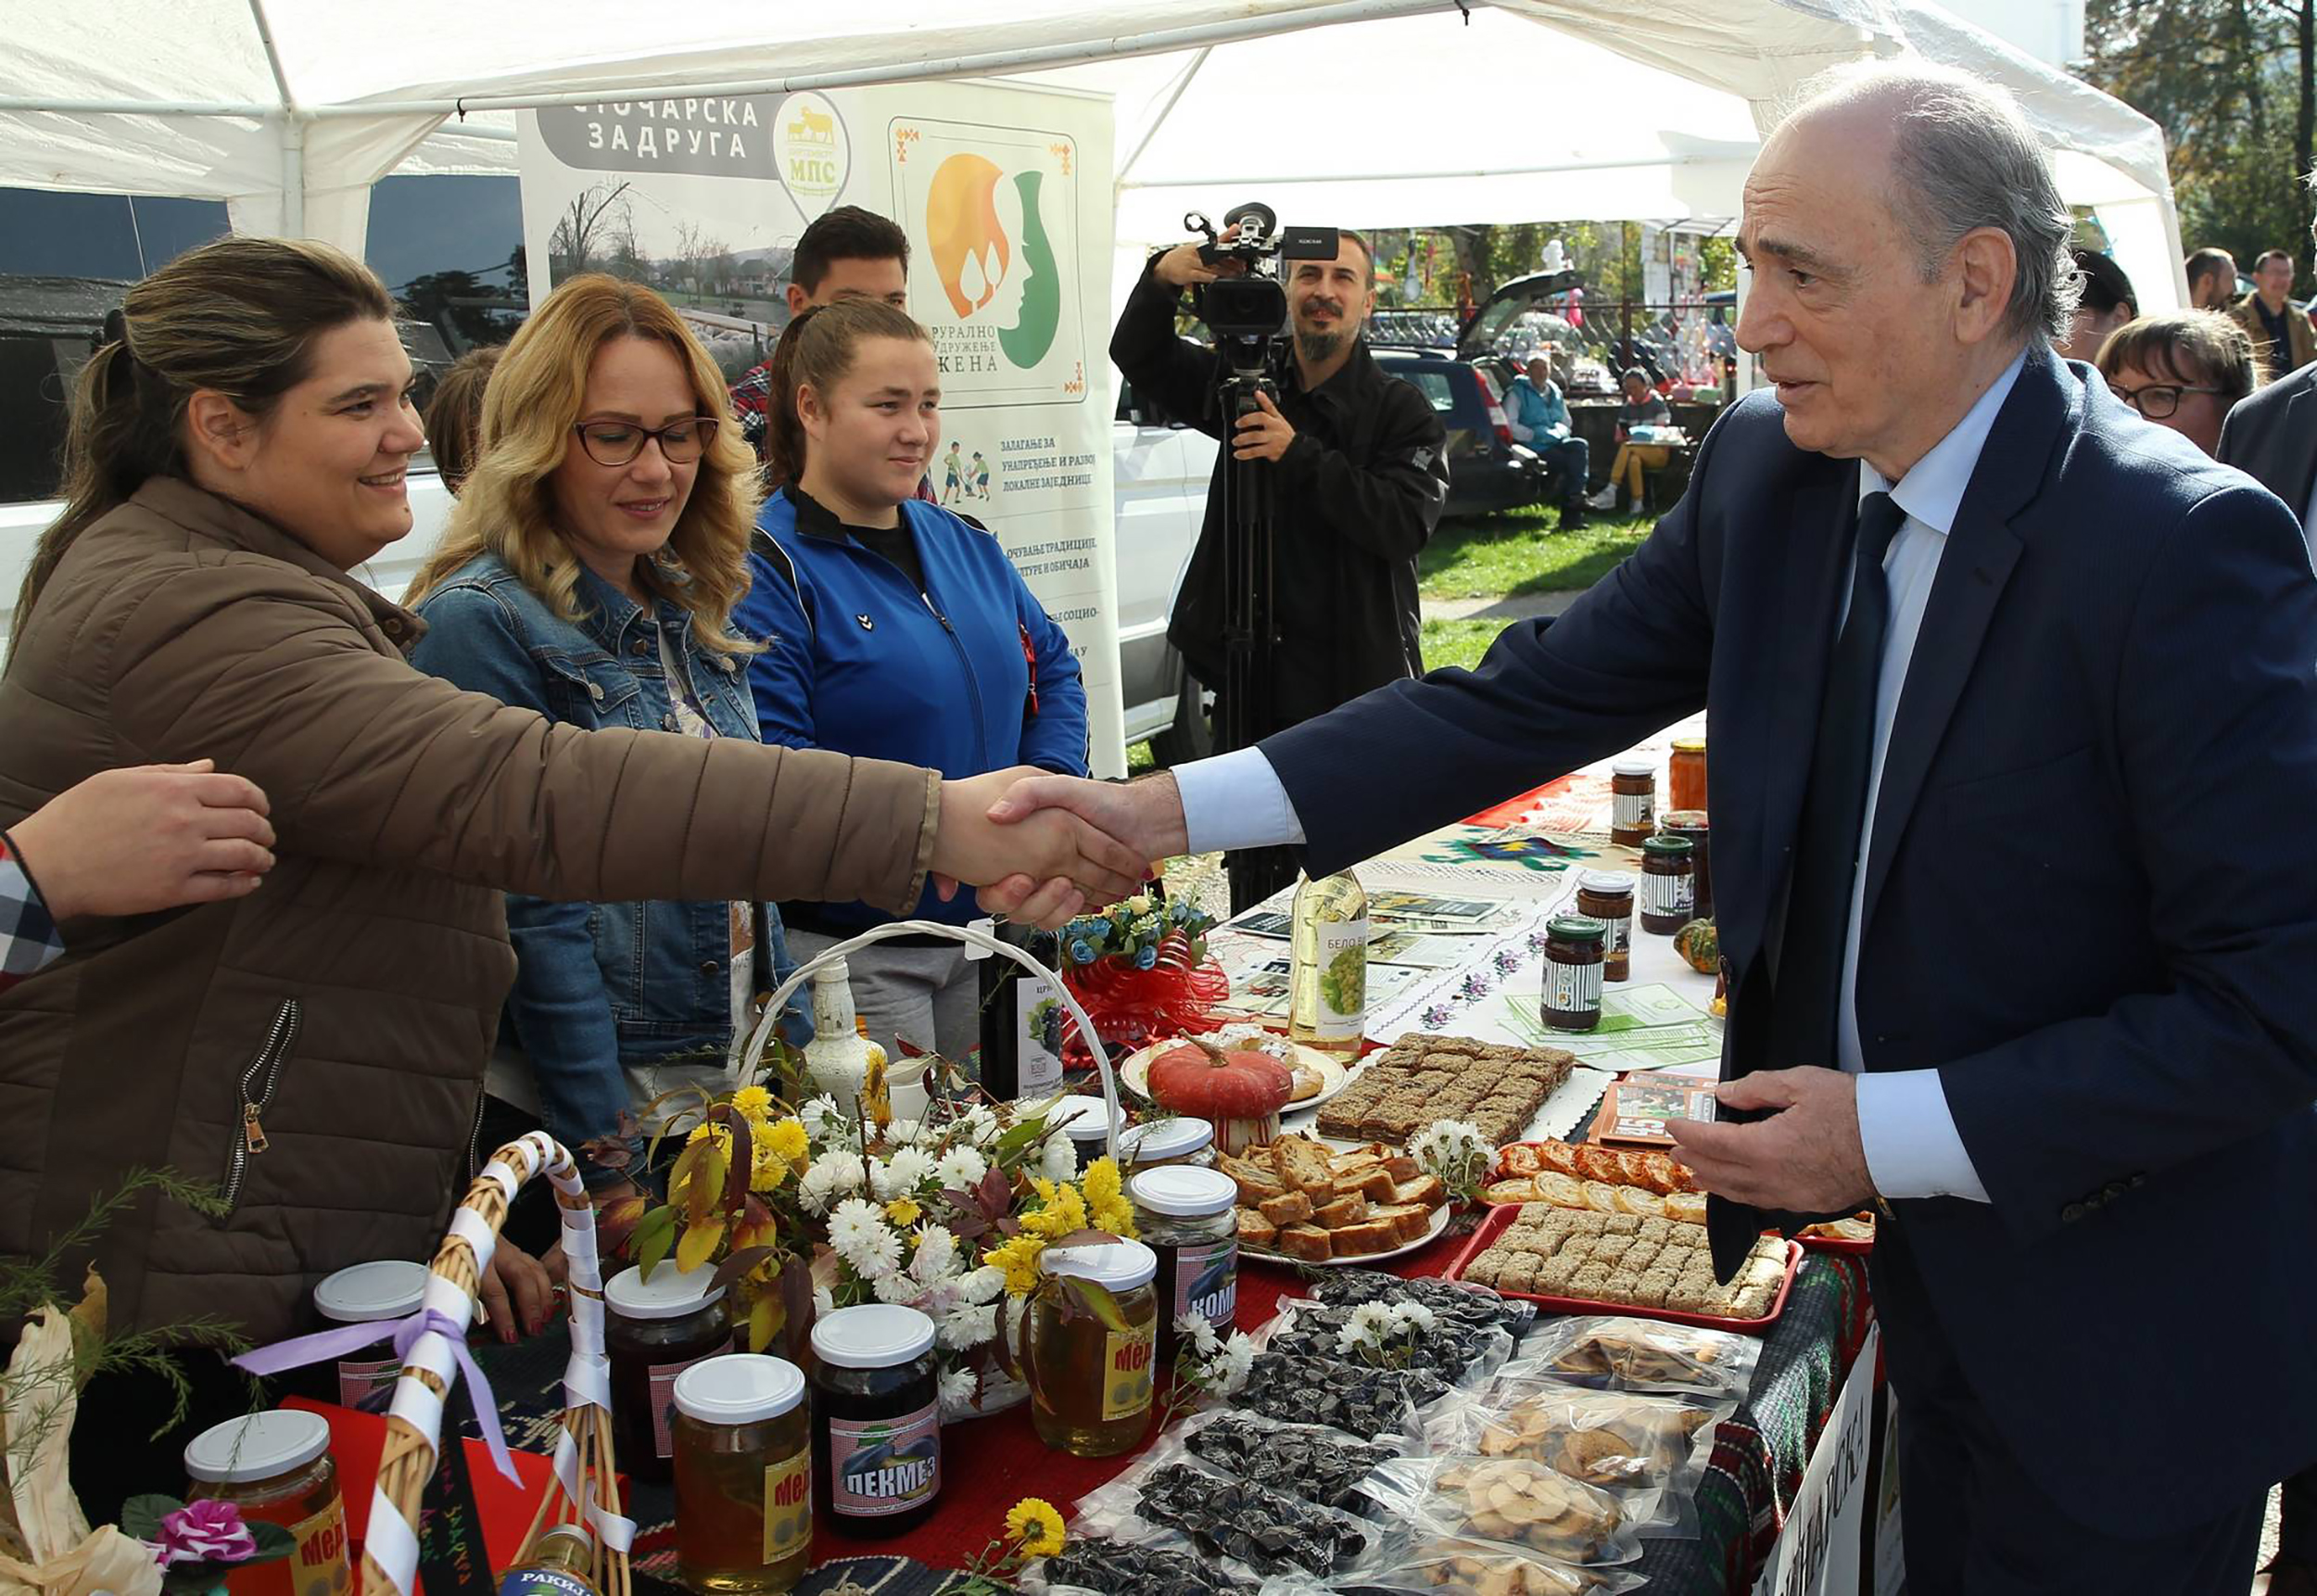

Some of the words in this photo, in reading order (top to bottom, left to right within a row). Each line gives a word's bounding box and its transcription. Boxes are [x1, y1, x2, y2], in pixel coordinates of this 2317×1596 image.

[587, 121, 746, 158] ЗАДРУГА
[789, 158, 835, 184] МПС
[931, 325, 995, 339] РУРАЛНО
[1327, 938, 1356, 949] БЕЛО
[847, 1456, 936, 1498] ПЕКМЕЗ
[520, 1572, 592, 1596] РАКИЈ
